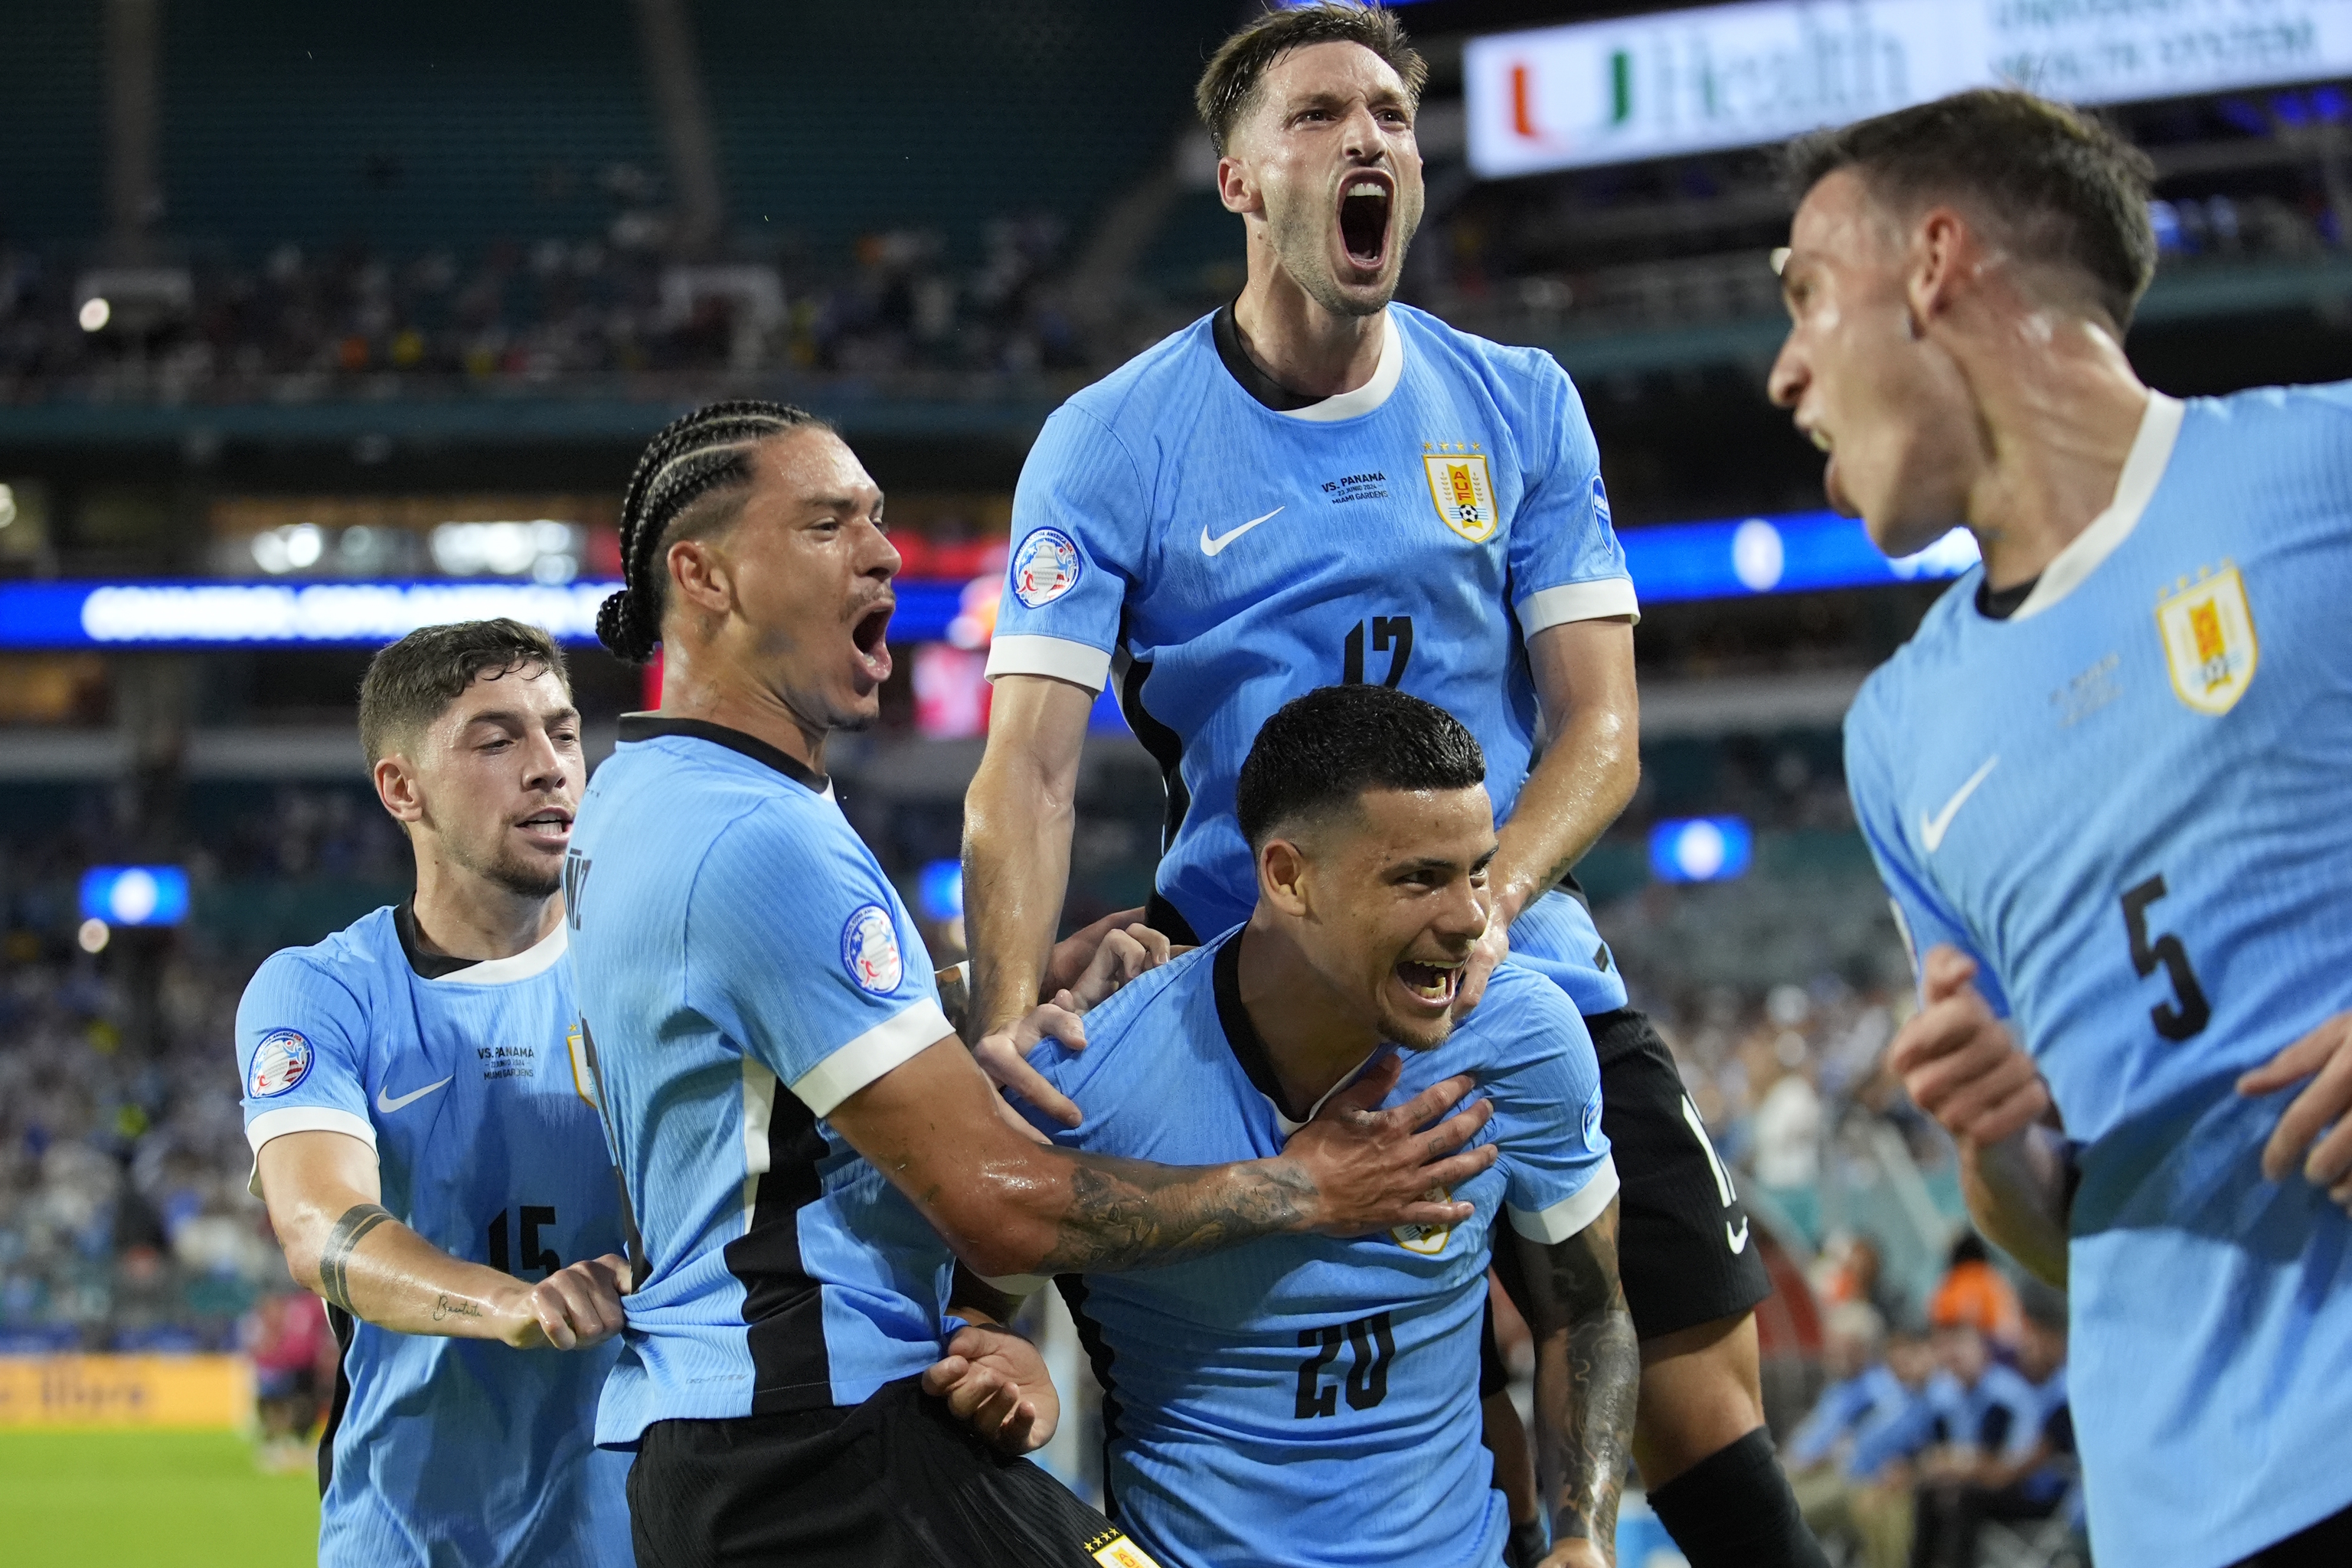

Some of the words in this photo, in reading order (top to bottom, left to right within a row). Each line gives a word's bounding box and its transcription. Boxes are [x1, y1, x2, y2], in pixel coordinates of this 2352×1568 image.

[1321, 482, 1340, 492] VS.
[1341, 470, 1387, 487] PANAMÁ
[1346, 485, 1363, 494] JUNIO
[1453, 471, 1472, 501] AUF
[1331, 495, 1354, 505] MIAMI
[1355, 490, 1389, 500] GARDENS
[1342, 616, 1413, 689] 17
[2120, 872, 2211, 1042] 5
[477, 1047, 494, 1059] VS.
[495, 1046, 534, 1058] PANAMÁ
[484, 1070, 502, 1080] MIAMI
[503, 1068, 534, 1077] GARDENS
[488, 1206, 560, 1276] 15
[1295, 1311, 1396, 1419] 20
